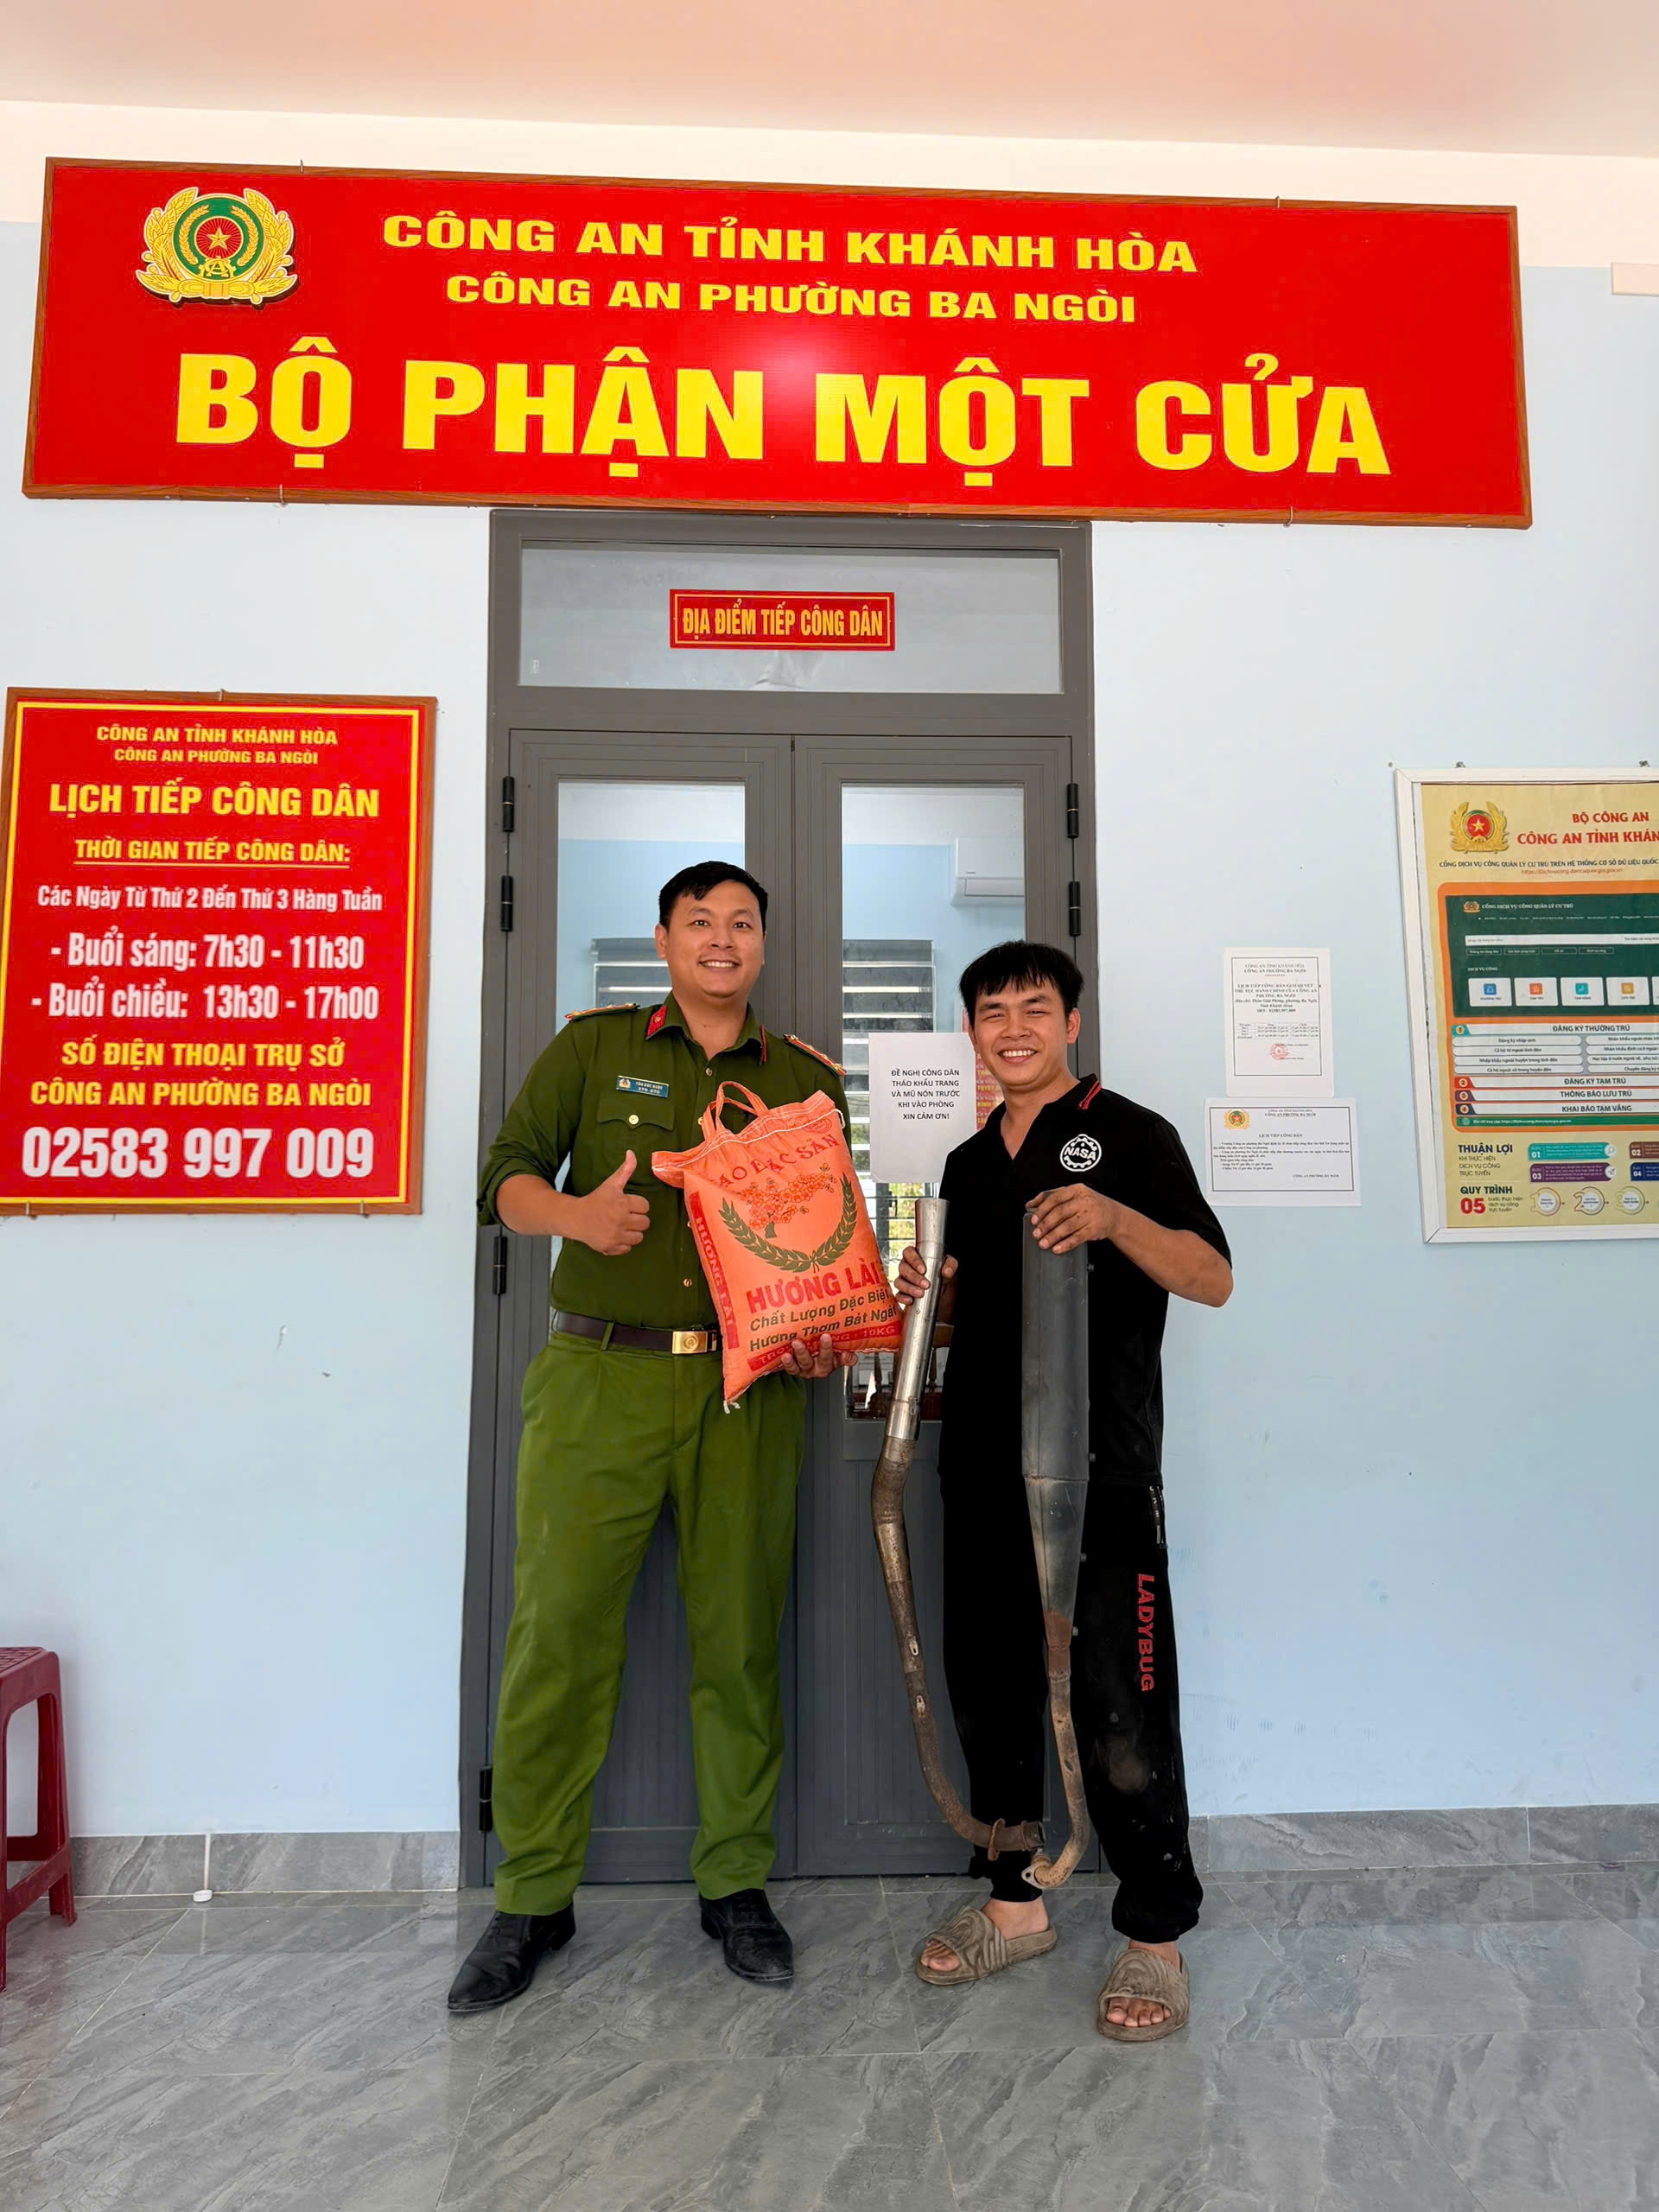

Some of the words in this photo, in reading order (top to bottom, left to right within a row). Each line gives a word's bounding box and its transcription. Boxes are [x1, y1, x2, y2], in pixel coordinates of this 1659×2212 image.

[384, 211, 554, 251] CÔNG
[576, 222, 662, 255] AN
[684, 217, 823, 261] TỈNH
[848, 228, 1053, 268] KHÁNH
[1077, 232, 1197, 272] HÒA
[448, 271, 589, 306] CÔNG
[608, 281, 680, 308] AN
[700, 282, 910, 316] PHƯỜNG
[930, 291, 996, 318] BA
[1014, 289, 1135, 322] NGÒI
[176, 336, 352, 468] BỘ
[403, 346, 766, 477] PHẬN
[814, 357, 1090, 486] MỘT
[1136, 353, 1390, 474] CỬA
[682, 608, 712, 642] ĐỊA
[714, 596, 758, 634] ĐIỂM
[761, 601, 795, 634] TIẾP
[801, 605, 844, 636] CÔNG
[850, 605, 882, 636] DÂN
[97, 724, 148, 741] CÔNG
[153, 728, 179, 741] AN
[185, 724, 226, 742] TỈNH
[232, 727, 295, 743] KHÁNH
[301, 728, 337, 744] HÒA
[115, 747, 156, 761] CÔNG
[162, 750, 183, 761] AN
[188, 748, 251, 763] PHƯỜNG
[255, 752, 276, 763] BA
[281, 750, 318, 764] NGÒI
[50, 784, 122, 818] LỊCH
[132, 778, 201, 814] TIẾP
[213, 781, 301, 816] CÔNG
[312, 783, 378, 817] DÂN
[1572, 811, 1589, 825] BỘ
[1592, 810, 1628, 823] CÔNG
[1631, 811, 1649, 822] AN
[75, 836, 121, 858] THỜI
[128, 841, 178, 859] GIAN
[185, 836, 230, 860] TIẾP
[237, 839, 294, 861] CÔNG
[301, 840, 350, 861] DÂN:
[1517, 831, 1557, 844] CÔNG
[1562, 832, 1582, 843] AN
[1586, 829, 1618, 842] TỈNH
[38, 885, 71, 906] Các
[76, 886, 121, 909] Ngày
[125, 887, 147, 907] Từ
[151, 887, 183, 907] Thứ
[186, 887, 198, 908] 2
[202, 885, 236, 908] Đến
[241, 888, 273, 908] Thứ
[276, 889, 288, 909] 3
[293, 889, 337, 912] Hàng
[342, 887, 382, 910] Tuần
[68, 925, 124, 966] Buổi
[130, 933, 196, 971] sáng:
[204, 935, 264, 968] 7h30
[290, 936, 364, 969] 11h30
[49, 976, 104, 1017] Buổi
[111, 978, 188, 1018] chiều:
[204, 985, 278, 1019] 13h30
[304, 986, 378, 1019] 17h00
[62, 1034, 97, 1065] SỐ
[104, 1039, 163, 1071] ĐIỆN
[172, 1044, 245, 1071] THOẠI
[253, 1044, 302, 1071] TRỤ
[309, 1037, 345, 1066] SỞ
[921, 1068, 943, 1077] CÔNG
[31, 1077, 101, 1104] CÔNG
[109, 1083, 145, 1105] AN
[153, 1077, 258, 1105] PHƯỜNG
[267, 1084, 301, 1105] BA
[309, 1078, 370, 1106] NGÒI
[22, 1127, 168, 1178] 02583
[184, 1128, 271, 1178] 997
[287, 1128, 373, 1178] 009
[1064, 1147, 1096, 1161] NASA
[1459, 1142, 1493, 1155] THUẬN
[1497, 1144, 1513, 1154] LỢI
[1484, 1184, 1513, 1194] TRÌNH
[1460, 1198, 1486, 1214] 05
[746, 1271, 842, 1314] HƯƠNG
[844, 1258, 880, 1291] LÀI
[749, 1306, 785, 1332] Chất
[802, 1323, 840, 1338] Thơm
[1136, 1573, 1155, 1692] LADYBUG
